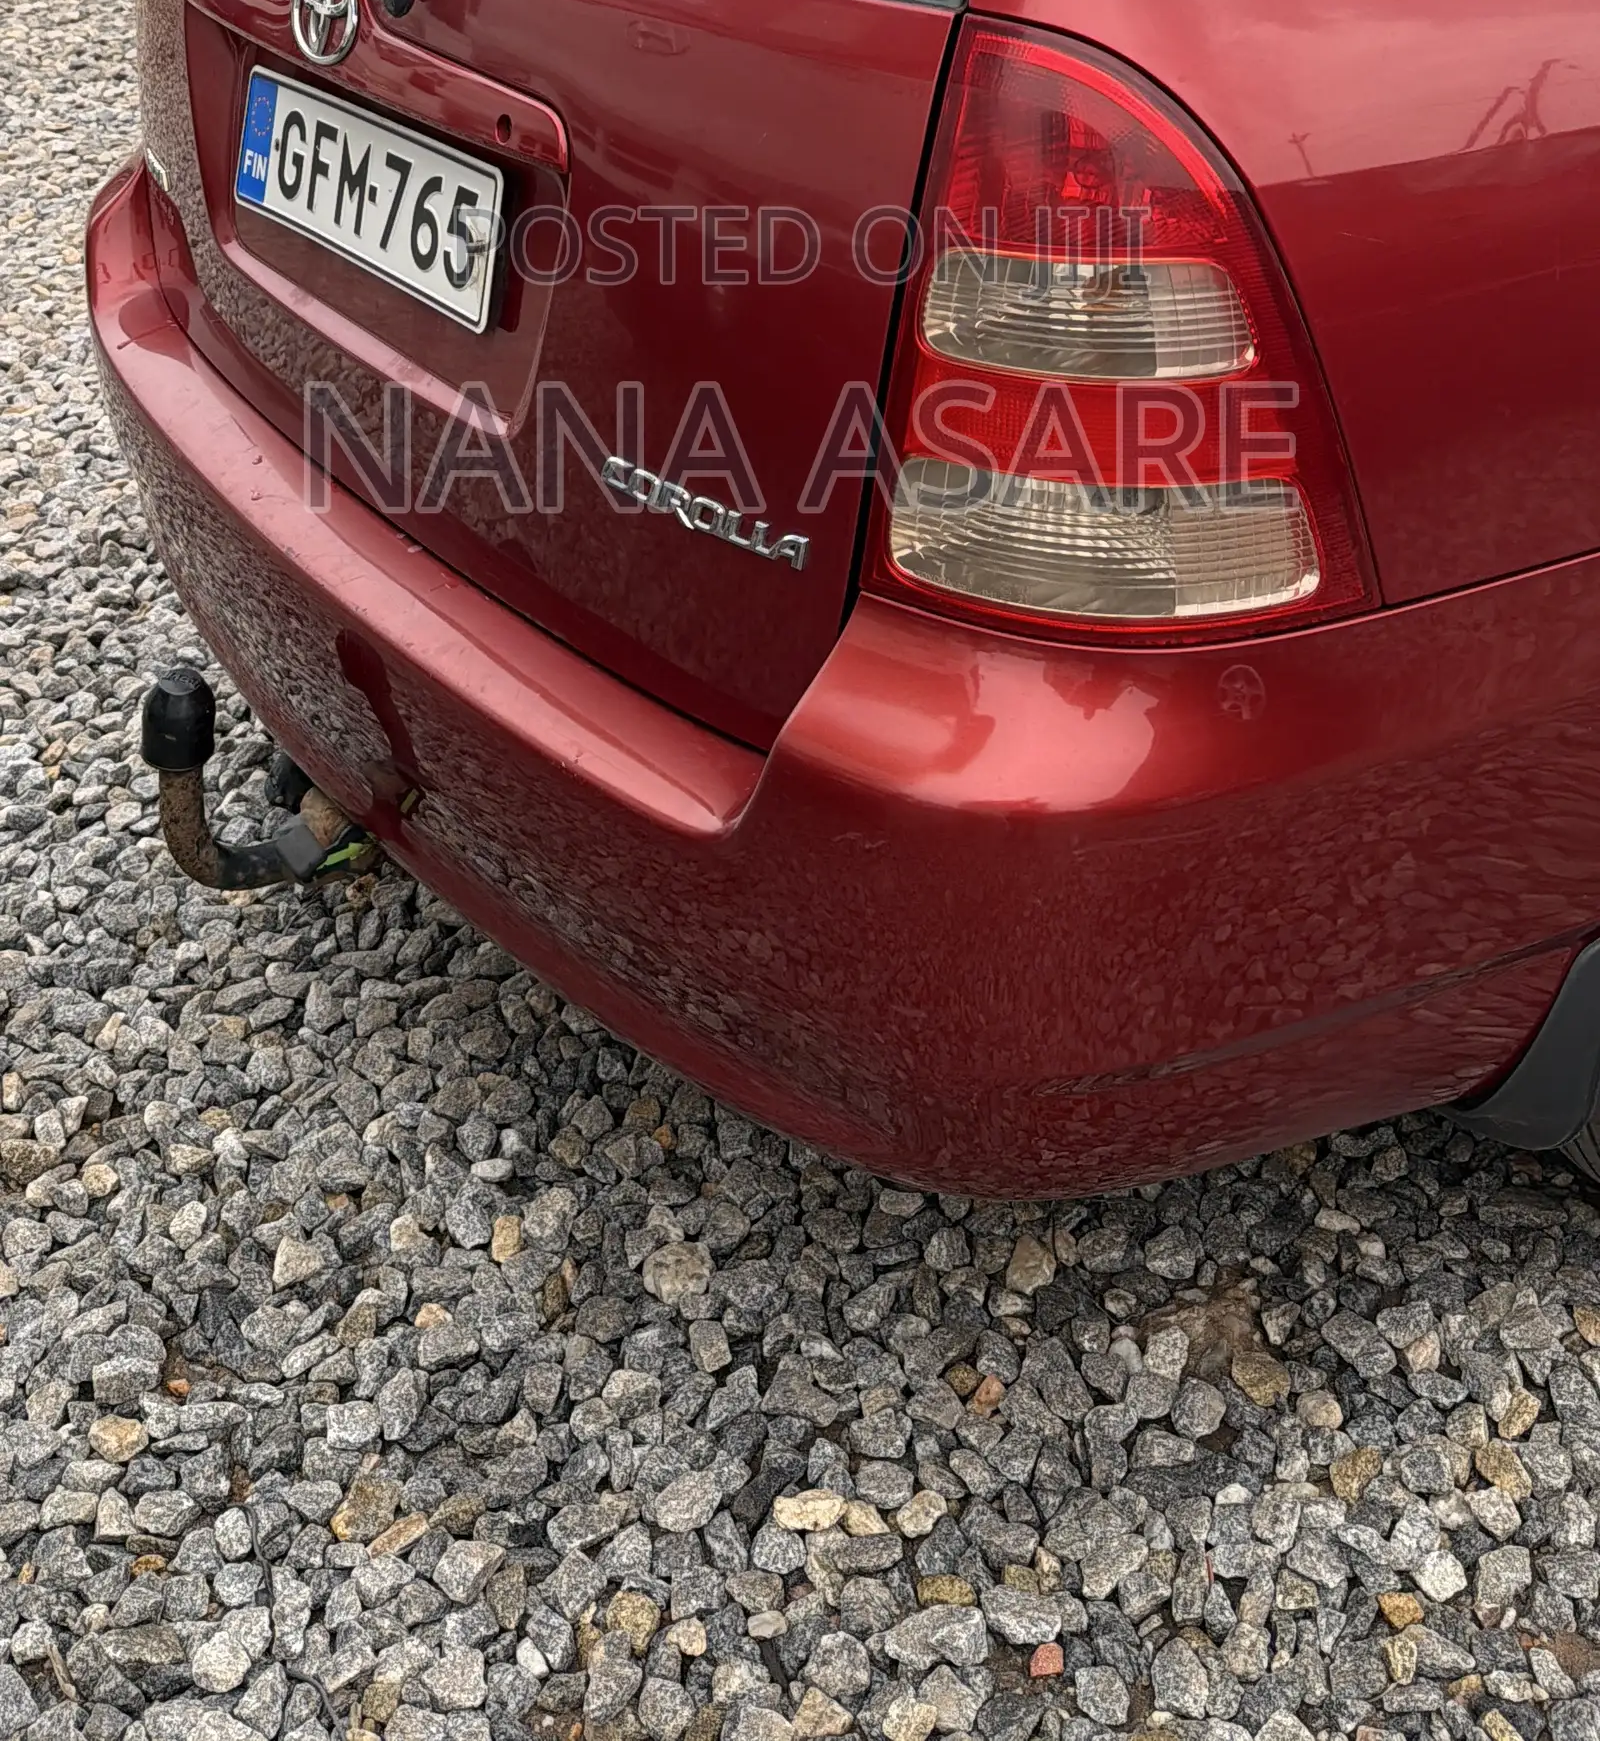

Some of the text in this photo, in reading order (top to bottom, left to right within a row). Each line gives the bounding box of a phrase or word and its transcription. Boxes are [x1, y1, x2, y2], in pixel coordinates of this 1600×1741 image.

[244, 150, 268, 183] FIN
[277, 109, 480, 291] GFM-765
[601, 456, 811, 572] COROLLA
